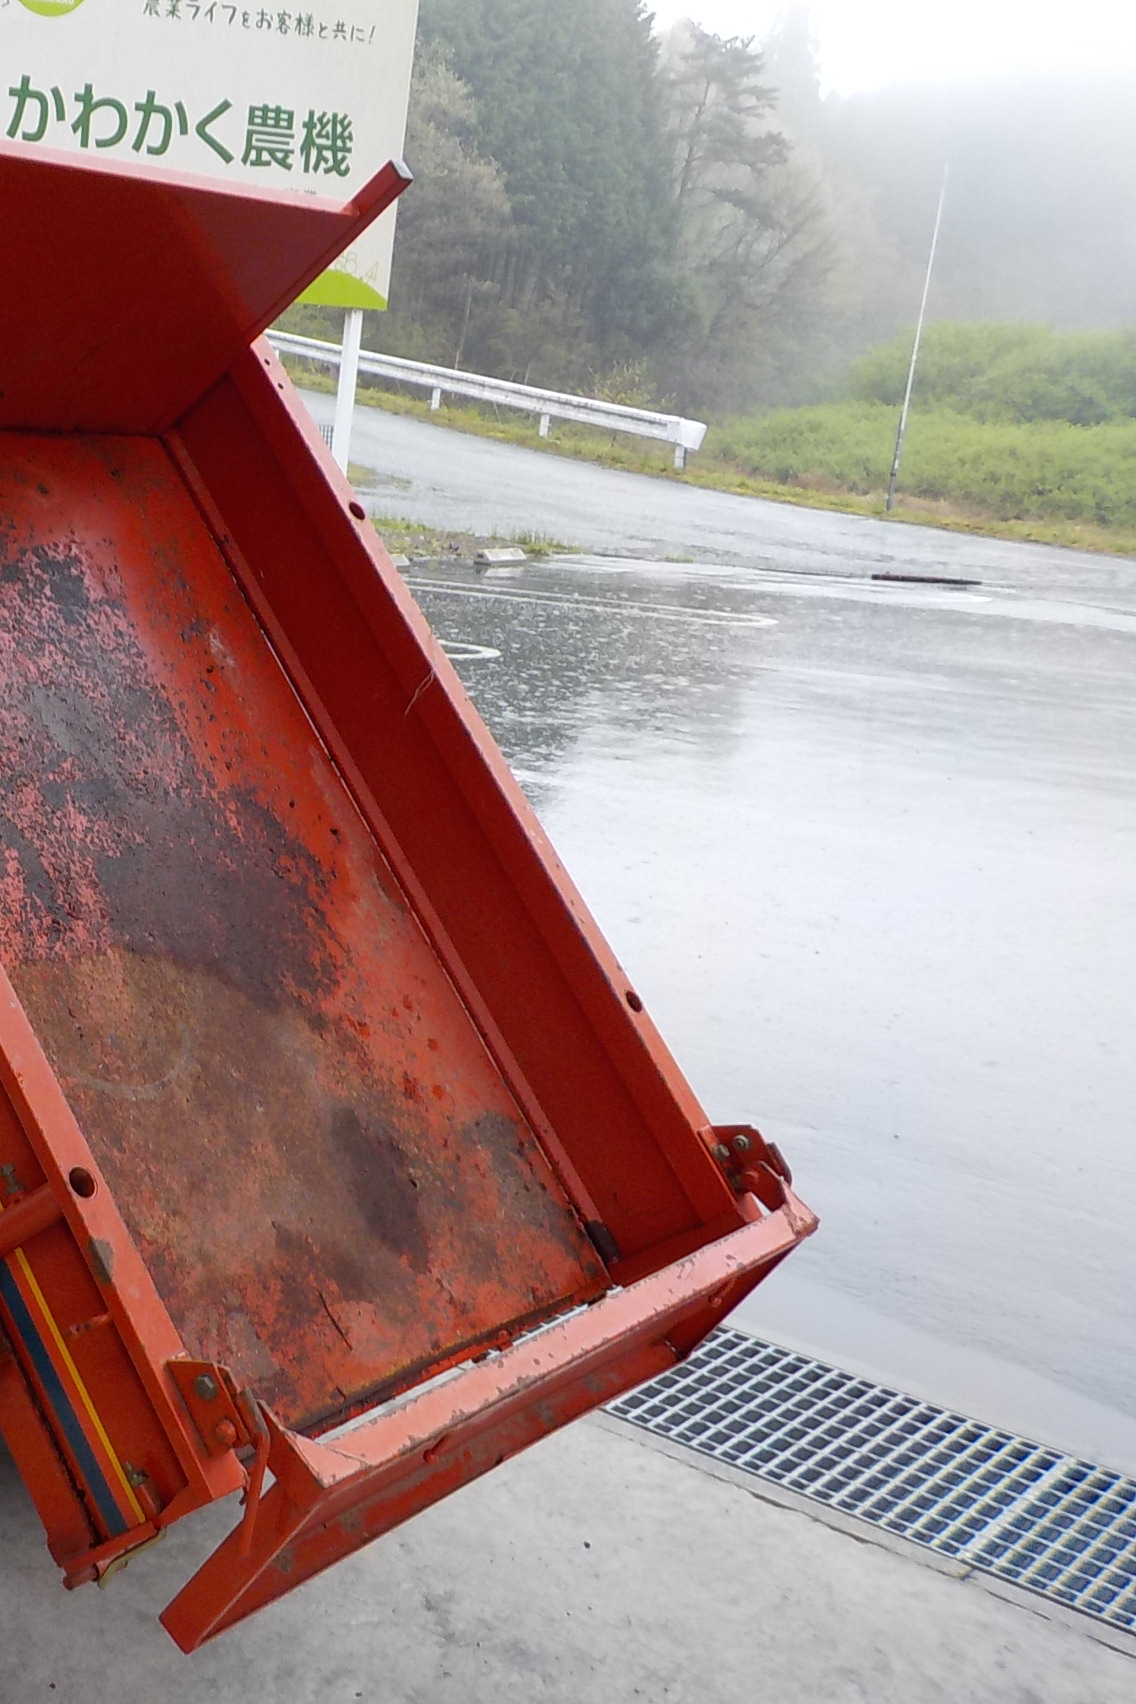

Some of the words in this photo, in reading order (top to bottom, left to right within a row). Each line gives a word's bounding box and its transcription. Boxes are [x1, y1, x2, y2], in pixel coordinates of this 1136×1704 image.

[6, 75, 354, 177] かわかく農機
